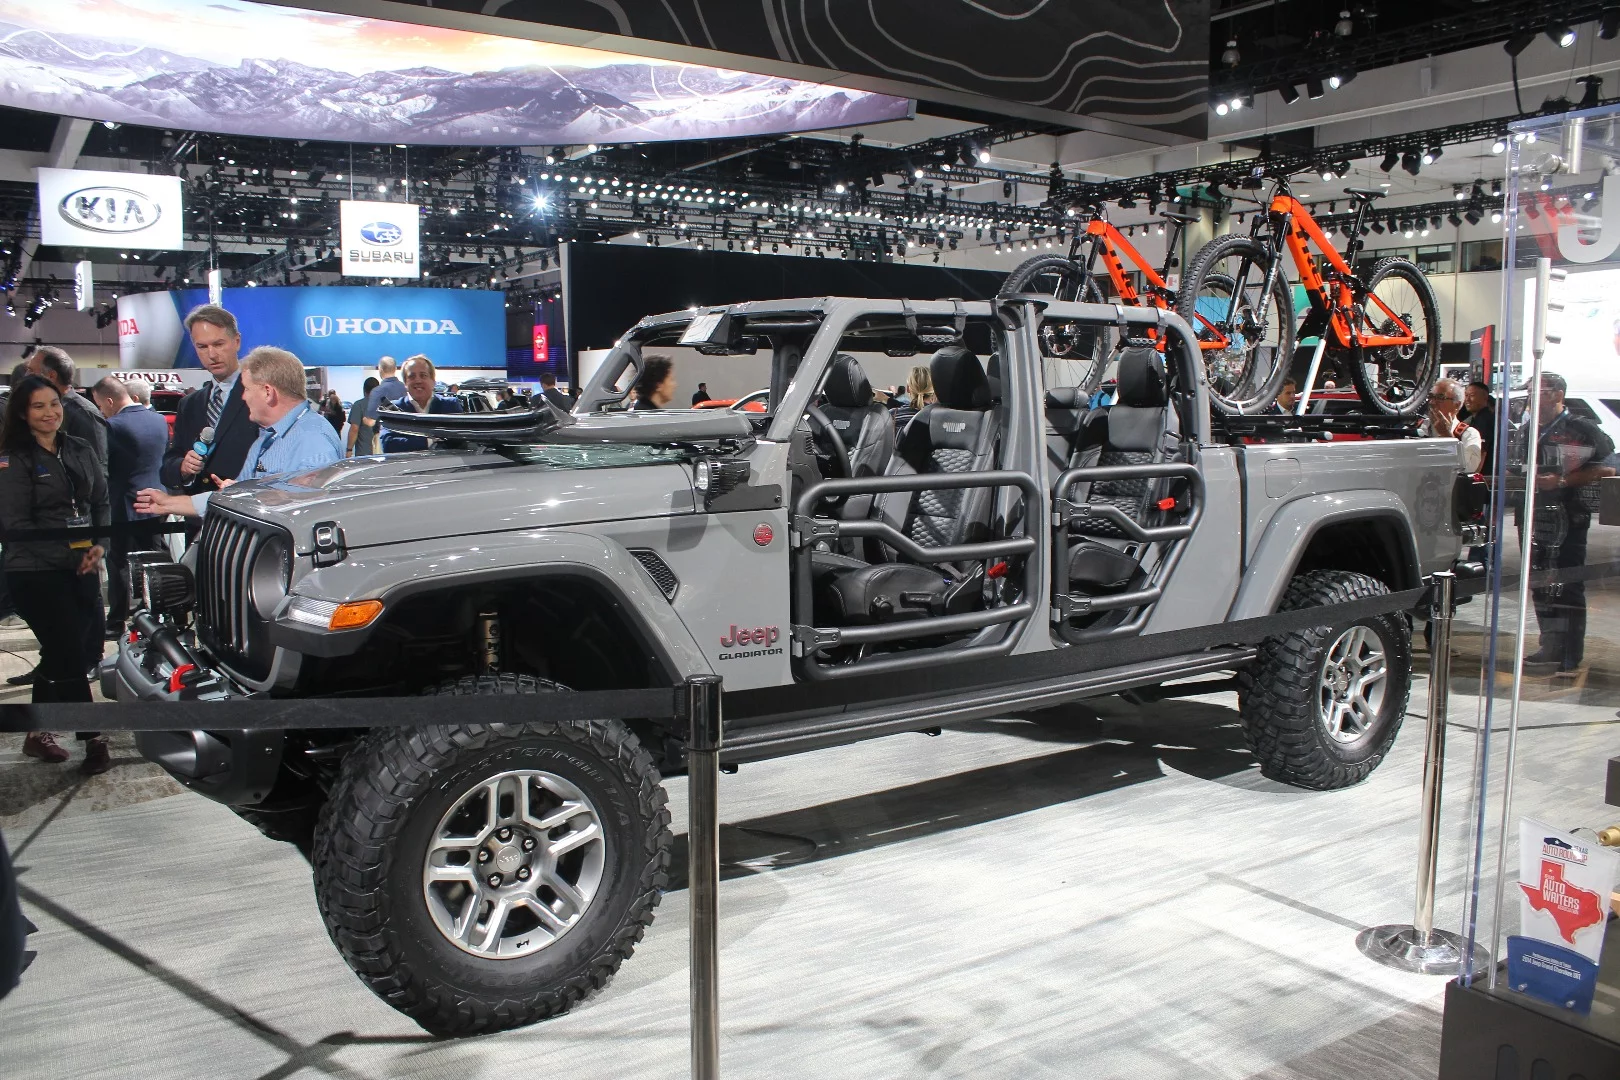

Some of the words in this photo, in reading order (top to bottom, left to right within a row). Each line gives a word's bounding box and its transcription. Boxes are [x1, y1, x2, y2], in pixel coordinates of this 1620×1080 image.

[75, 196, 145, 224] KIA
[349, 249, 414, 264] SUBARU
[335, 318, 462, 335] HONDA
[720, 623, 780, 648] Jeep
[718, 648, 783, 661] GLADIATOR
[1542, 844, 1558, 857] AUTO
[1543, 878, 1566, 896] AUTO
[1542, 889, 1580, 911] WRITERS
